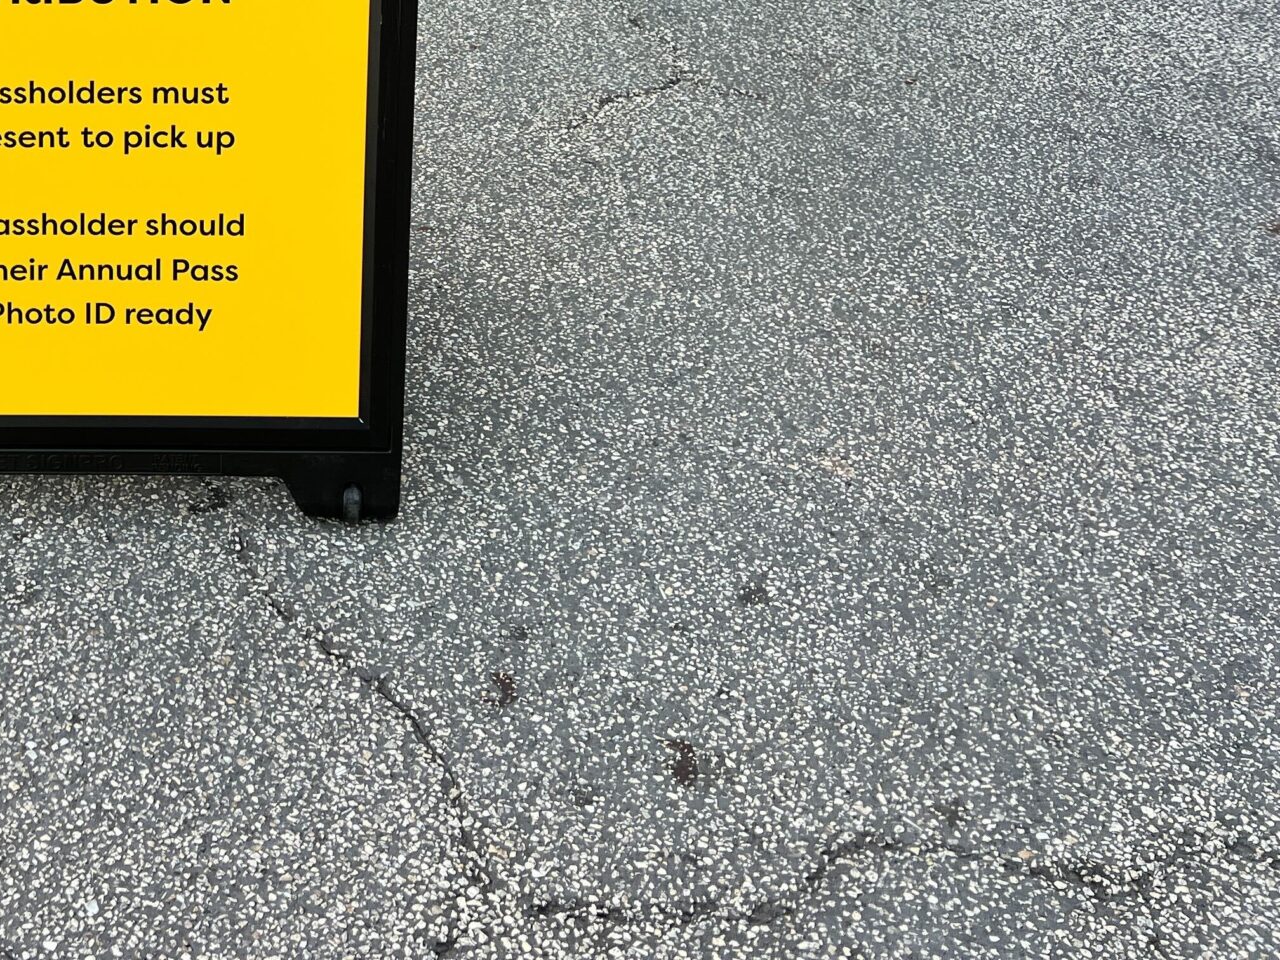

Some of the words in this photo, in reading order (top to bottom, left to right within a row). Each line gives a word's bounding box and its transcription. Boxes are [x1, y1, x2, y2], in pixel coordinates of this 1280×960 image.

[152, 82, 230, 105] must
[80, 126, 114, 148] to
[124, 124, 188, 155] pick
[196, 130, 235, 156] up
[145, 212, 245, 237] should
[56, 258, 161, 281] Annual
[172, 258, 239, 282] Pass
[85, 302, 116, 325] ID
[125, 302, 213, 332] ready
